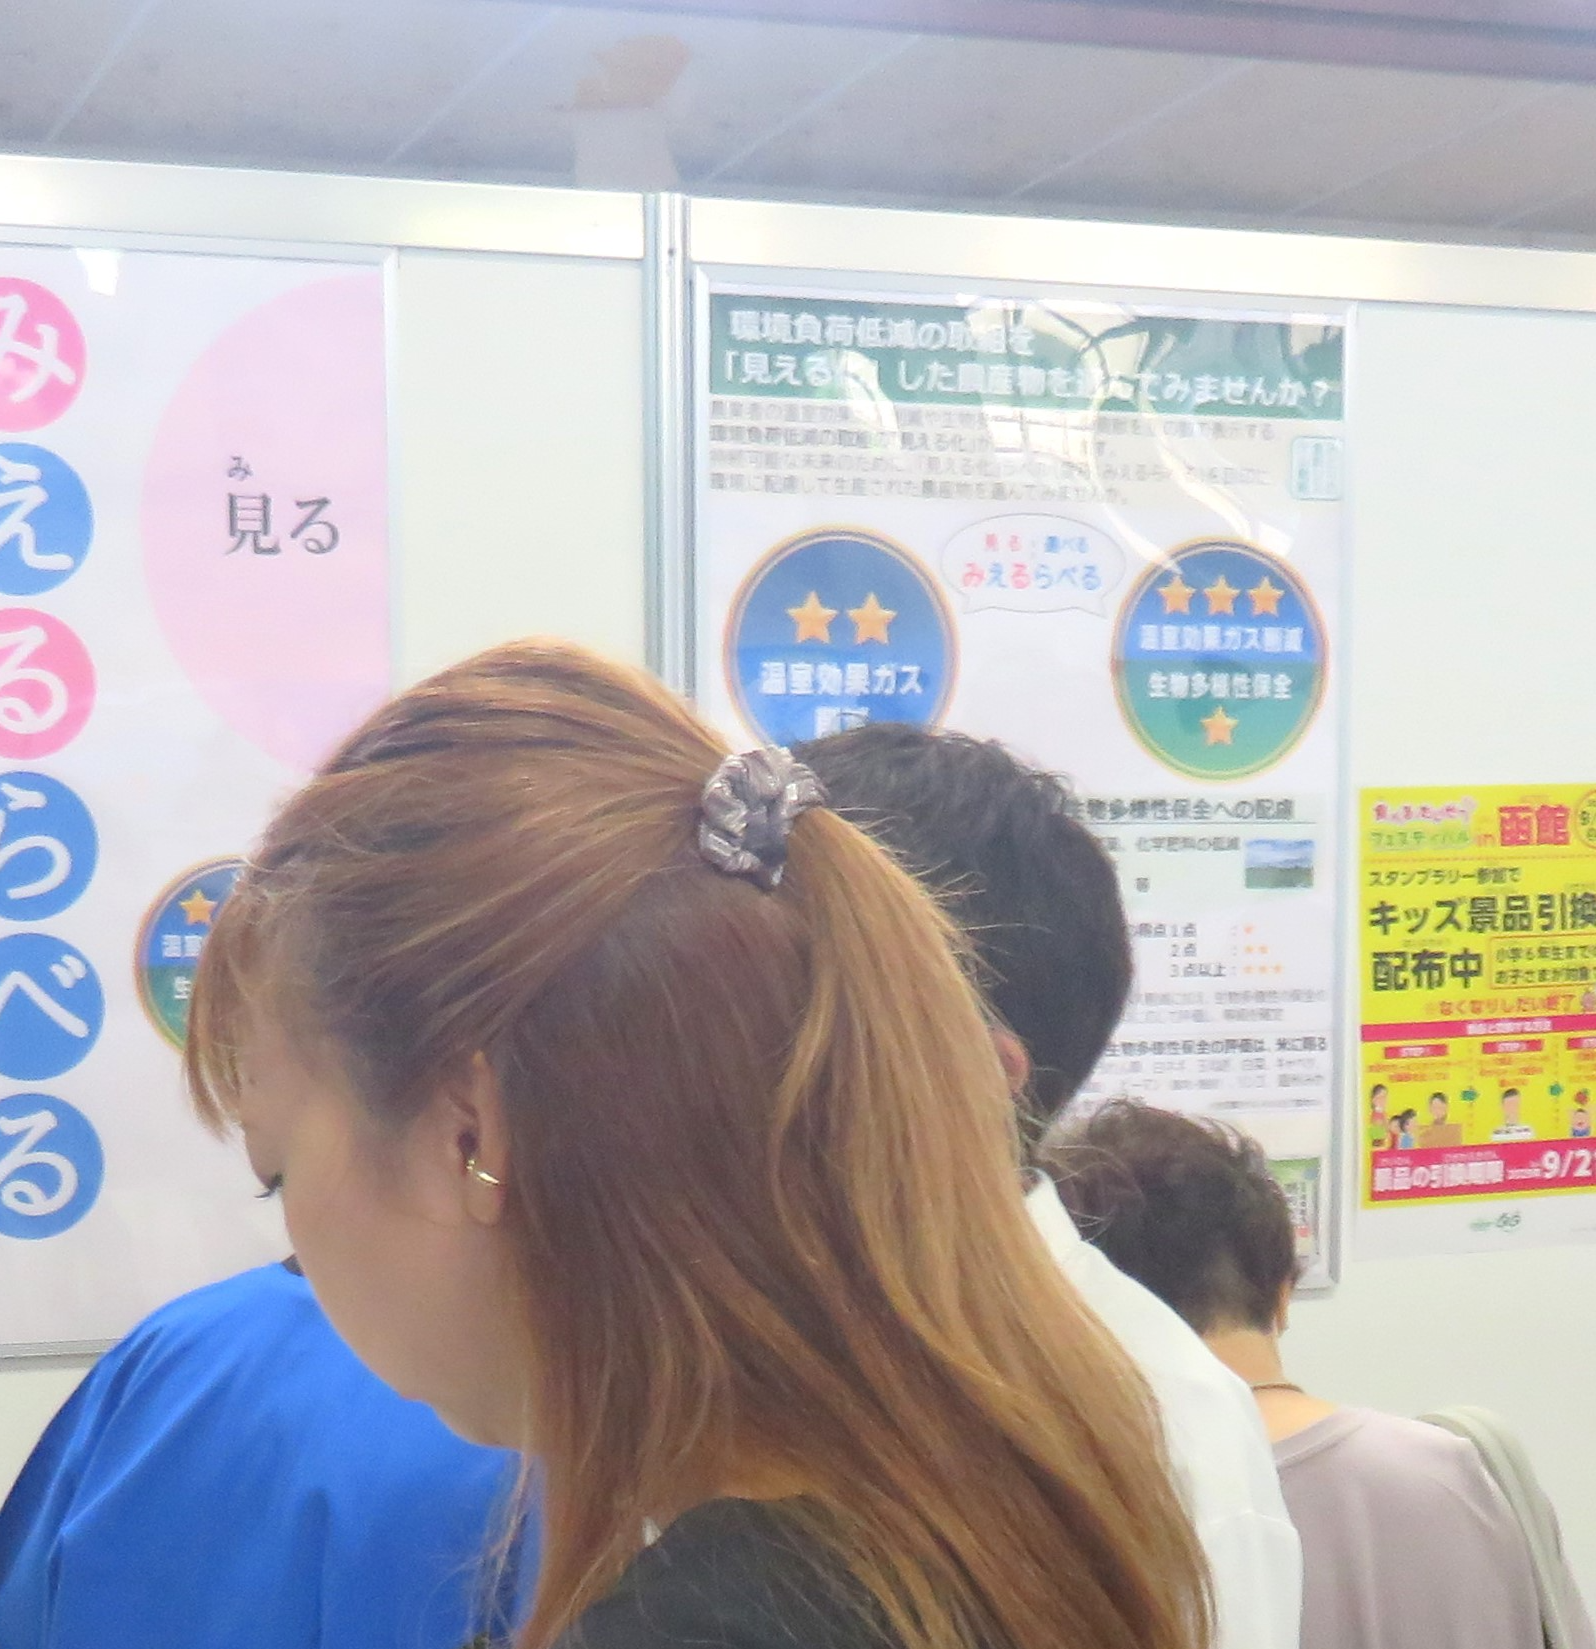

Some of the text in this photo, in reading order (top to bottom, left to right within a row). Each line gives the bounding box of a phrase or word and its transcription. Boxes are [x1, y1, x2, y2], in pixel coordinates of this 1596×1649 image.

[228, 455, 253, 479] み
[224, 491, 342, 557] 見る
[962, 562, 1102, 591] みえるらべる
[1371, 947, 1484, 992] 配布中
